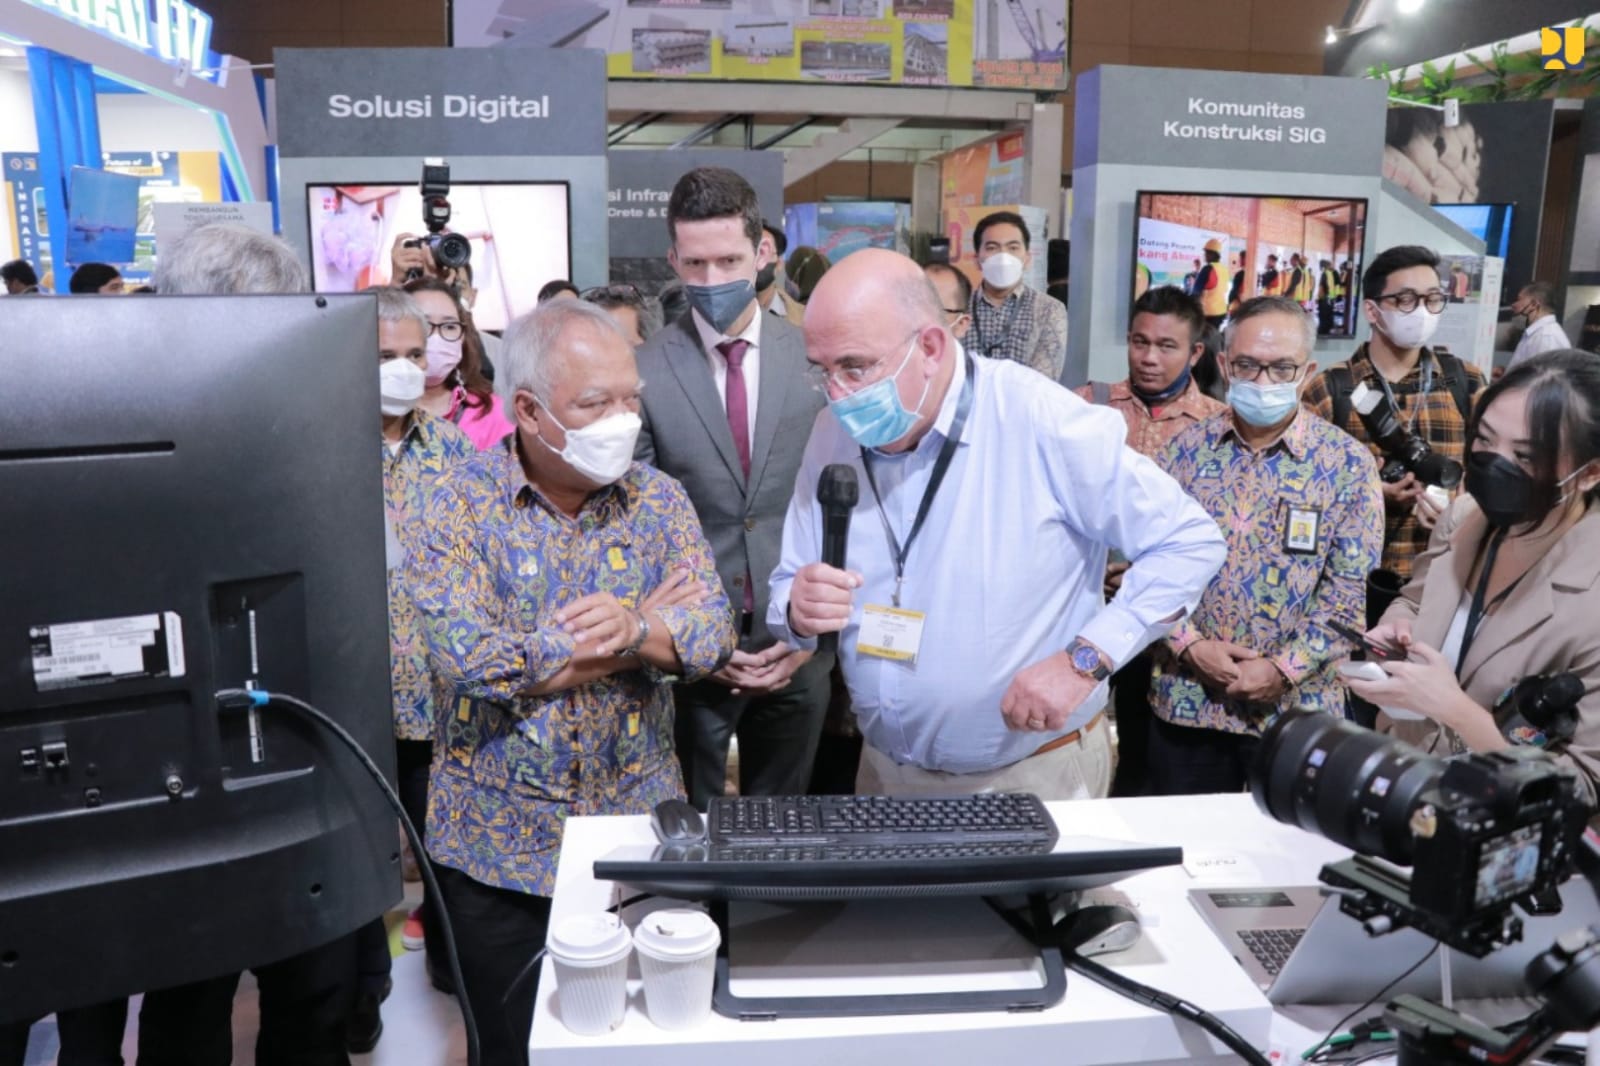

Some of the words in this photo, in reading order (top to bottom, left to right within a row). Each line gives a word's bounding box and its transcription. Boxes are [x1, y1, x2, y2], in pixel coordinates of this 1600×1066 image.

[328, 94, 432, 118] Solusi
[443, 95, 549, 123] Digital
[1188, 97, 1305, 119] Komunitas
[1164, 121, 1282, 142] Konstruksi
[1289, 126, 1327, 144] SIG
[627, 188, 672, 202] Infra
[608, 207, 643, 217] Crete
